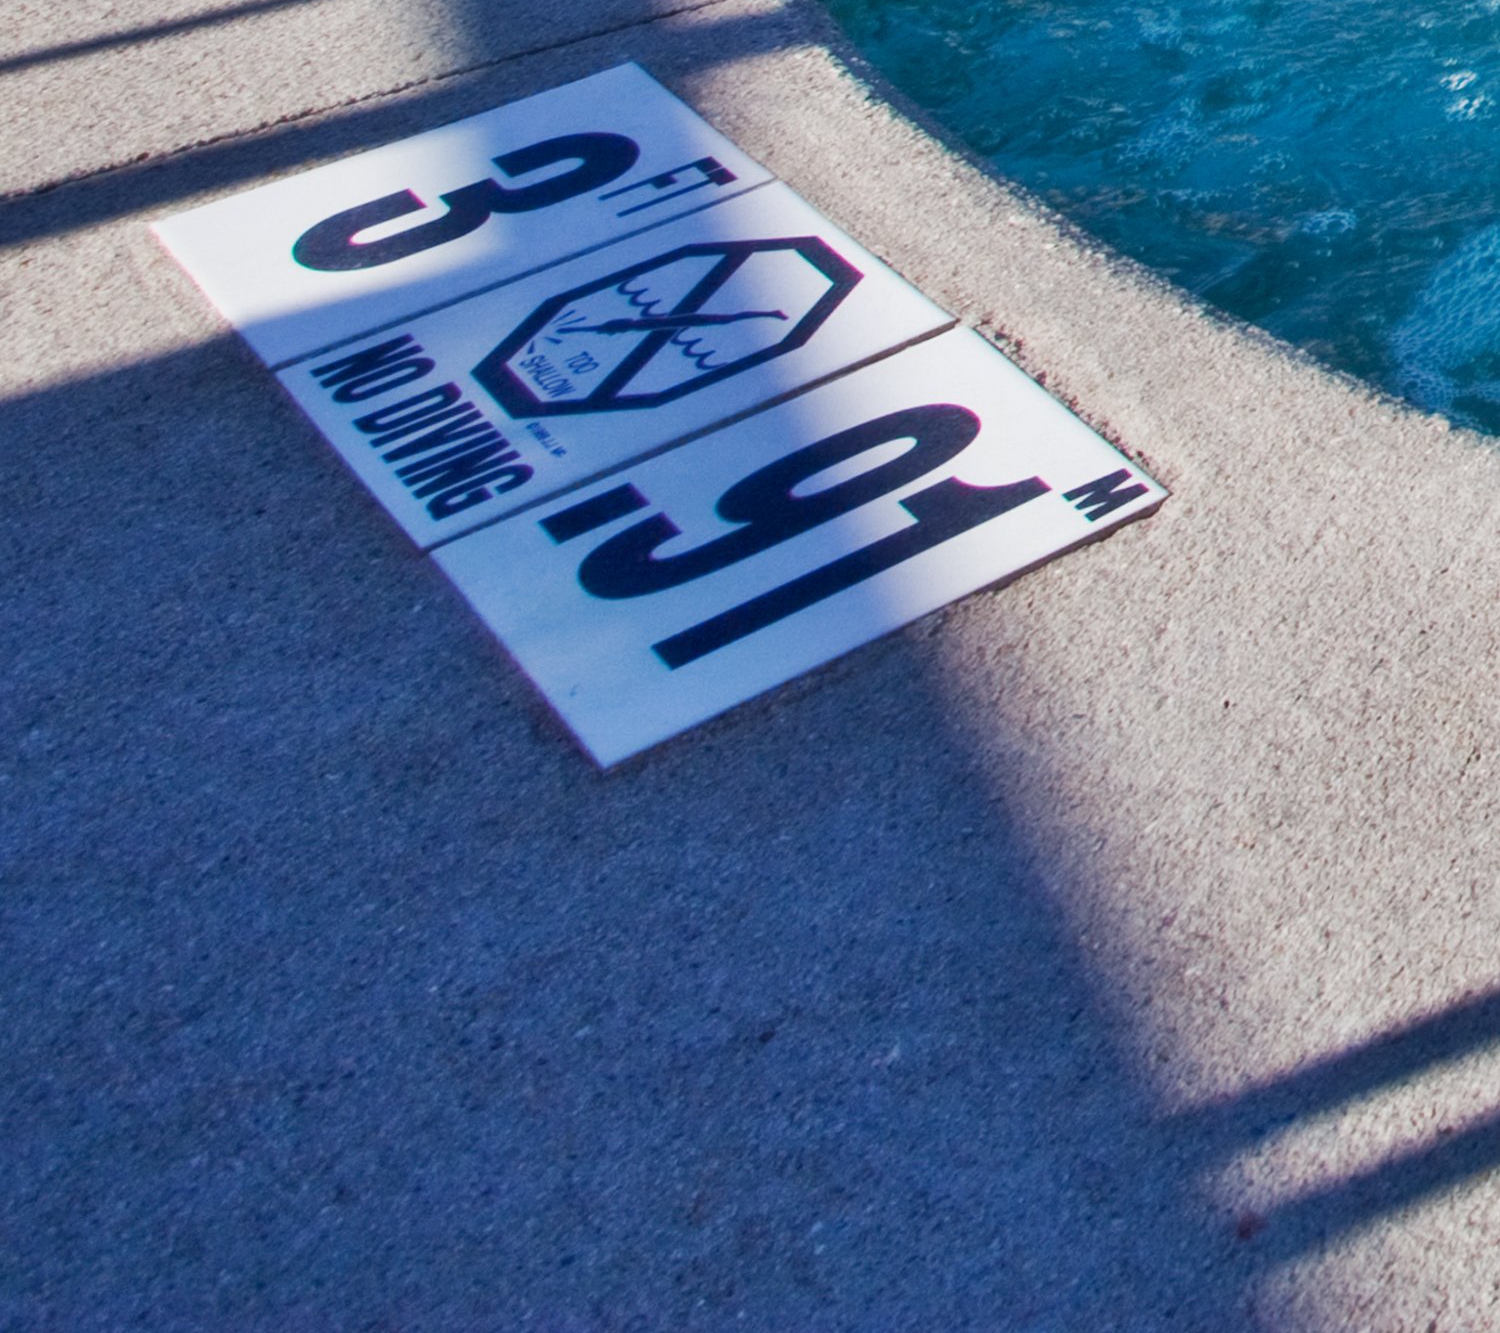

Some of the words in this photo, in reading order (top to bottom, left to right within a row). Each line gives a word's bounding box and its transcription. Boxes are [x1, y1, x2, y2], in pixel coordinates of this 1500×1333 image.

[291, 131, 640, 272] 3
[597, 156, 738, 218] FT
[309, 333, 436, 404] NO
[518, 355, 577, 399] SHALLOW
[564, 351, 600, 375] TOO
[352, 381, 535, 522] DIVING
[1062, 468, 1151, 524] M
